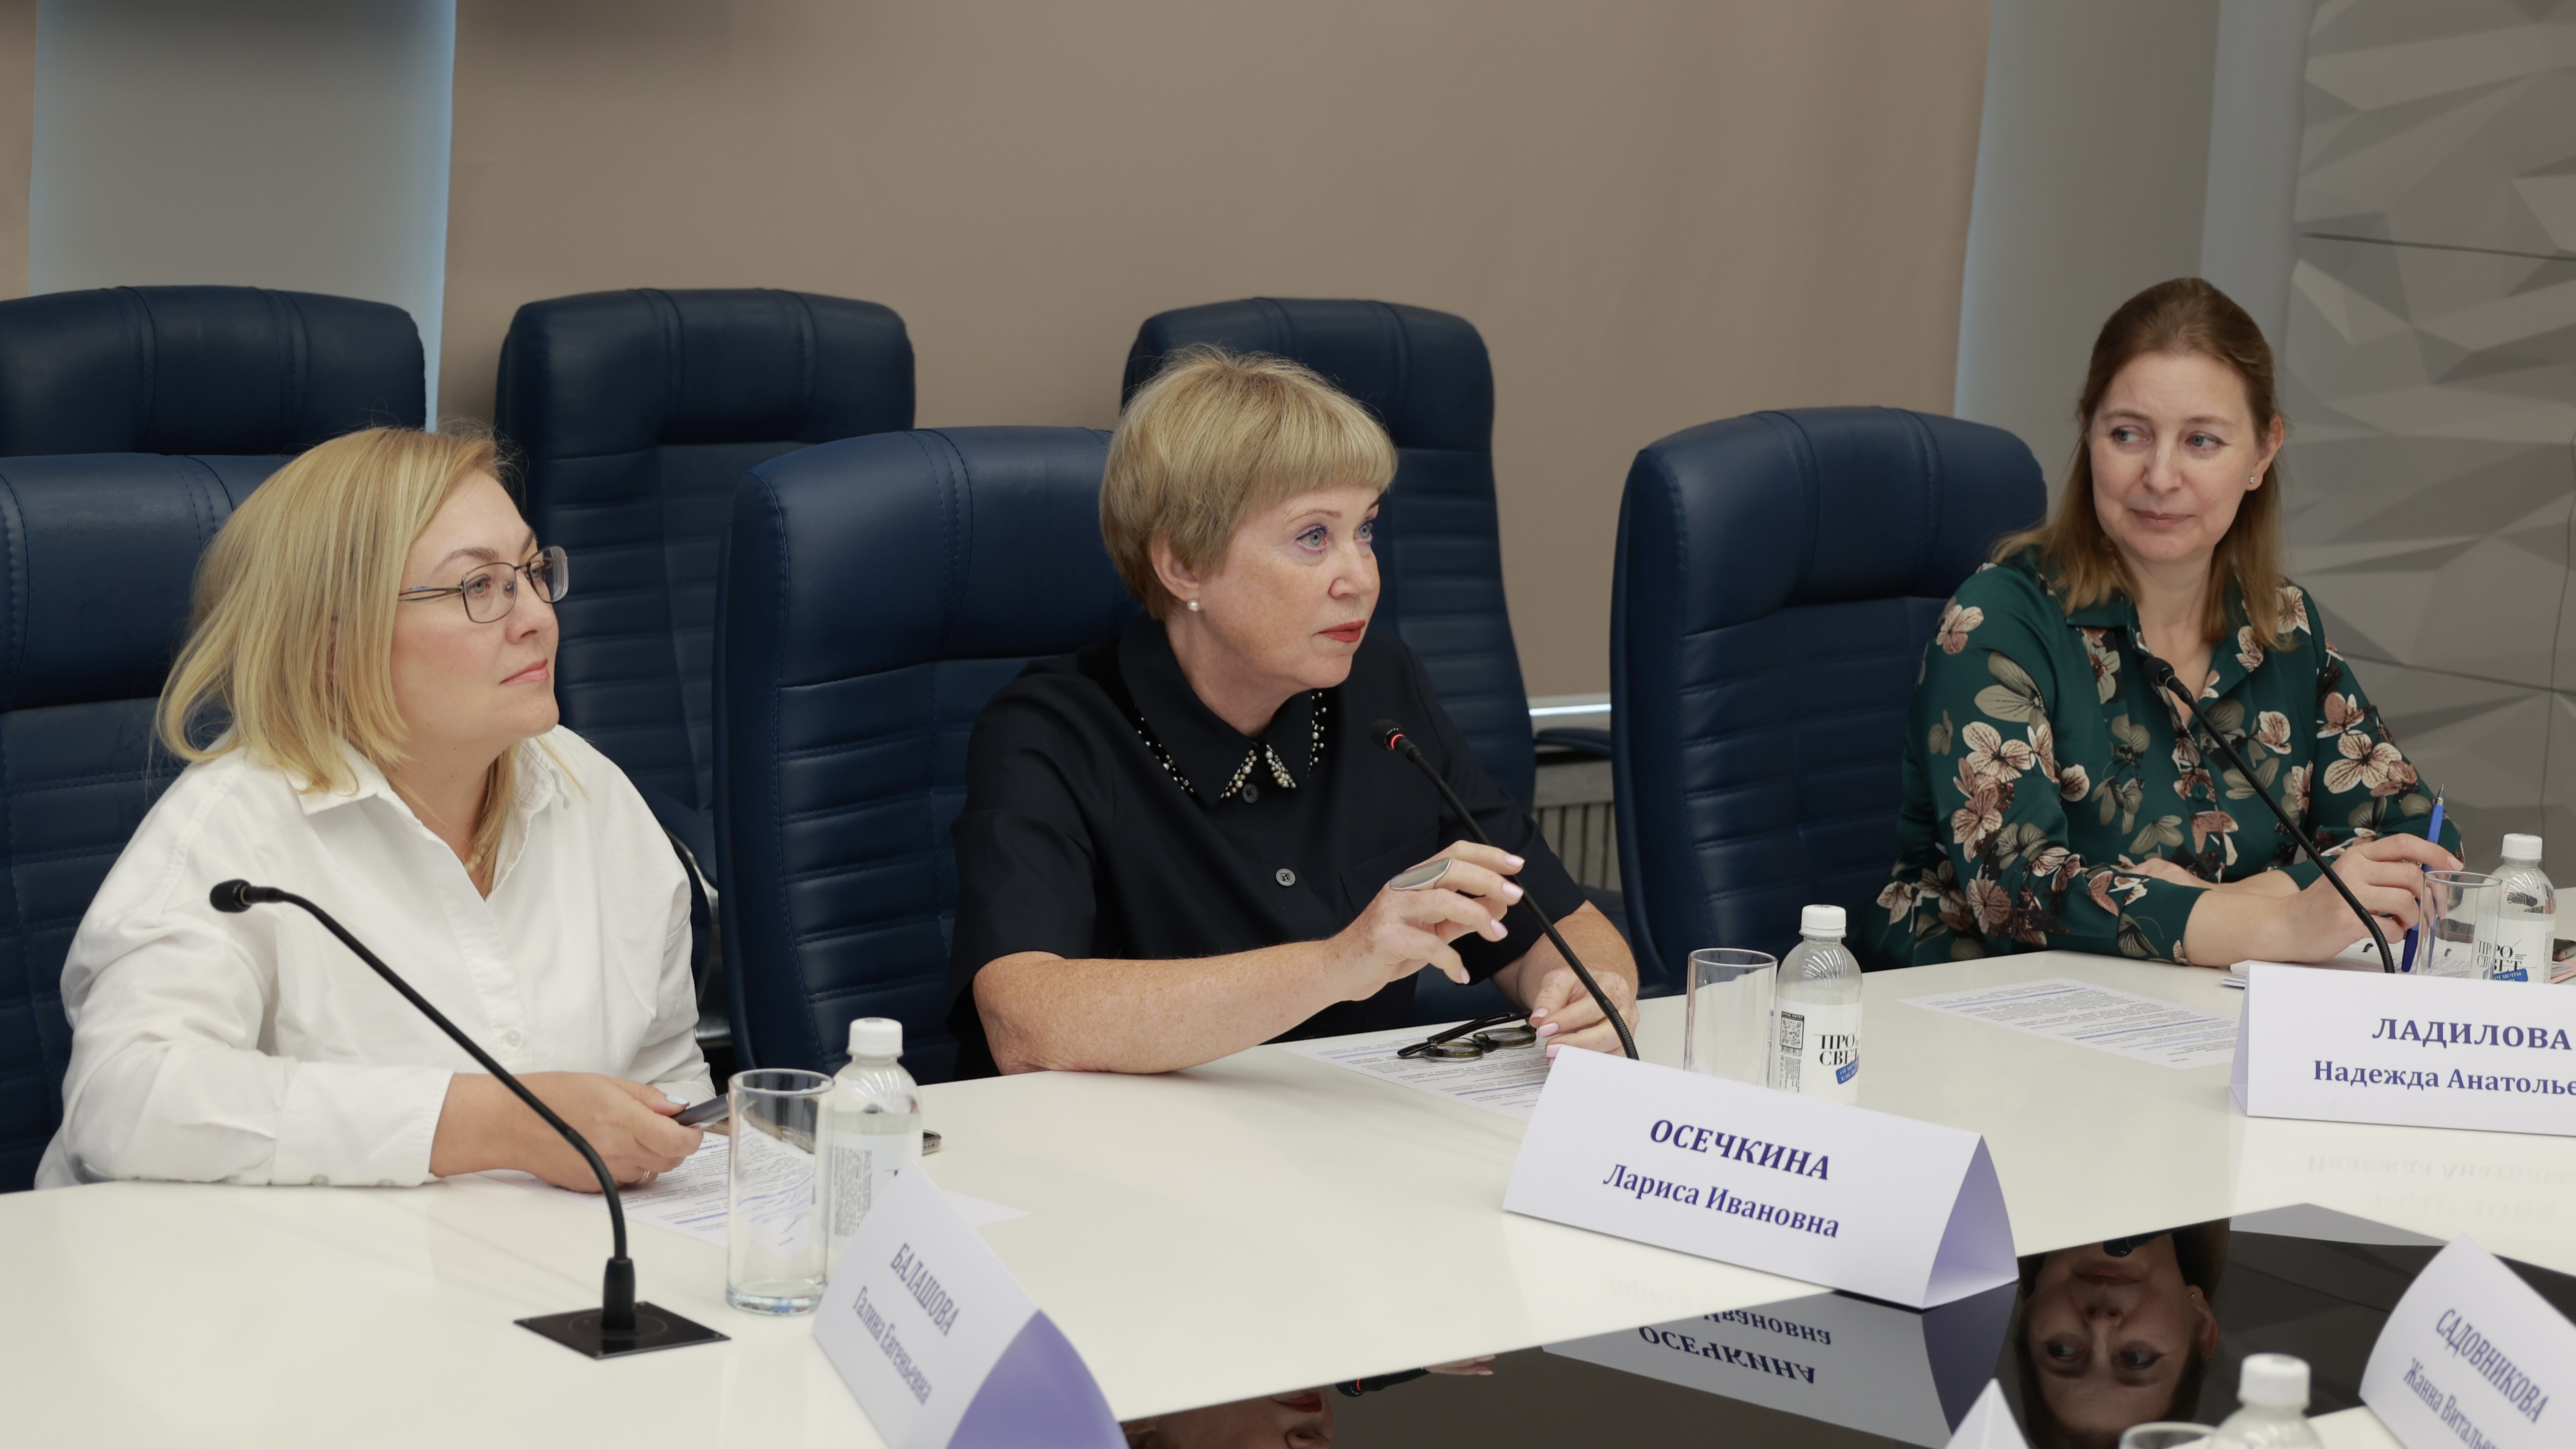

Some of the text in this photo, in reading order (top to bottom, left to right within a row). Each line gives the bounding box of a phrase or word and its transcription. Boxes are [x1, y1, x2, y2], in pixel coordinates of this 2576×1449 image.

[1819, 1033, 1855, 1050] ПРО
[2372, 1018, 2572, 1050] ЛАДИЛОВА
[2314, 1060, 2439, 1091] Надежда
[1650, 1119, 1829, 1180] ОСЕЧКИНА
[1603, 1164, 1839, 1238] Лариса Ивановна
[890, 1241, 960, 1337] БАЛАШОВА
[853, 1285, 886, 1342] Галина
[880, 1321, 932, 1406] Евгеньевна
[2435, 1308, 2549, 1424] САДОВНИКОВА
[2403, 1357, 2444, 1414] Жанна
